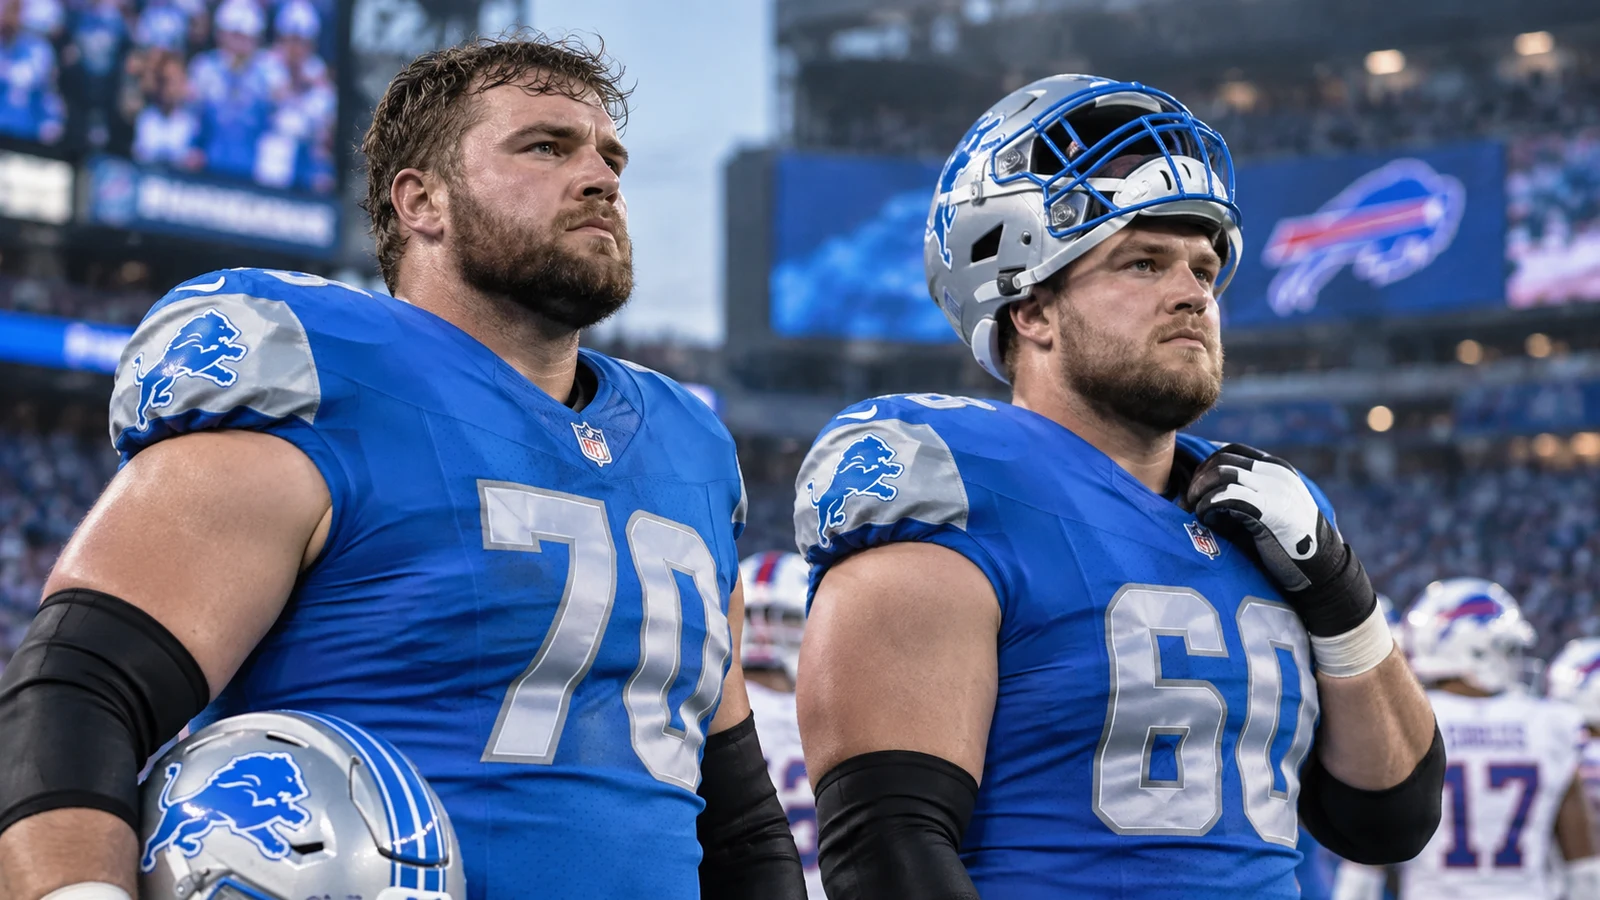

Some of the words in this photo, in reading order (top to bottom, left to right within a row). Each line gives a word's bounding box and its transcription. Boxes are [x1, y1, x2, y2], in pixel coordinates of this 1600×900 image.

[476, 479, 732, 793] 70
[1092, 583, 1320, 849] 60
[1443, 761, 1540, 868] 17
